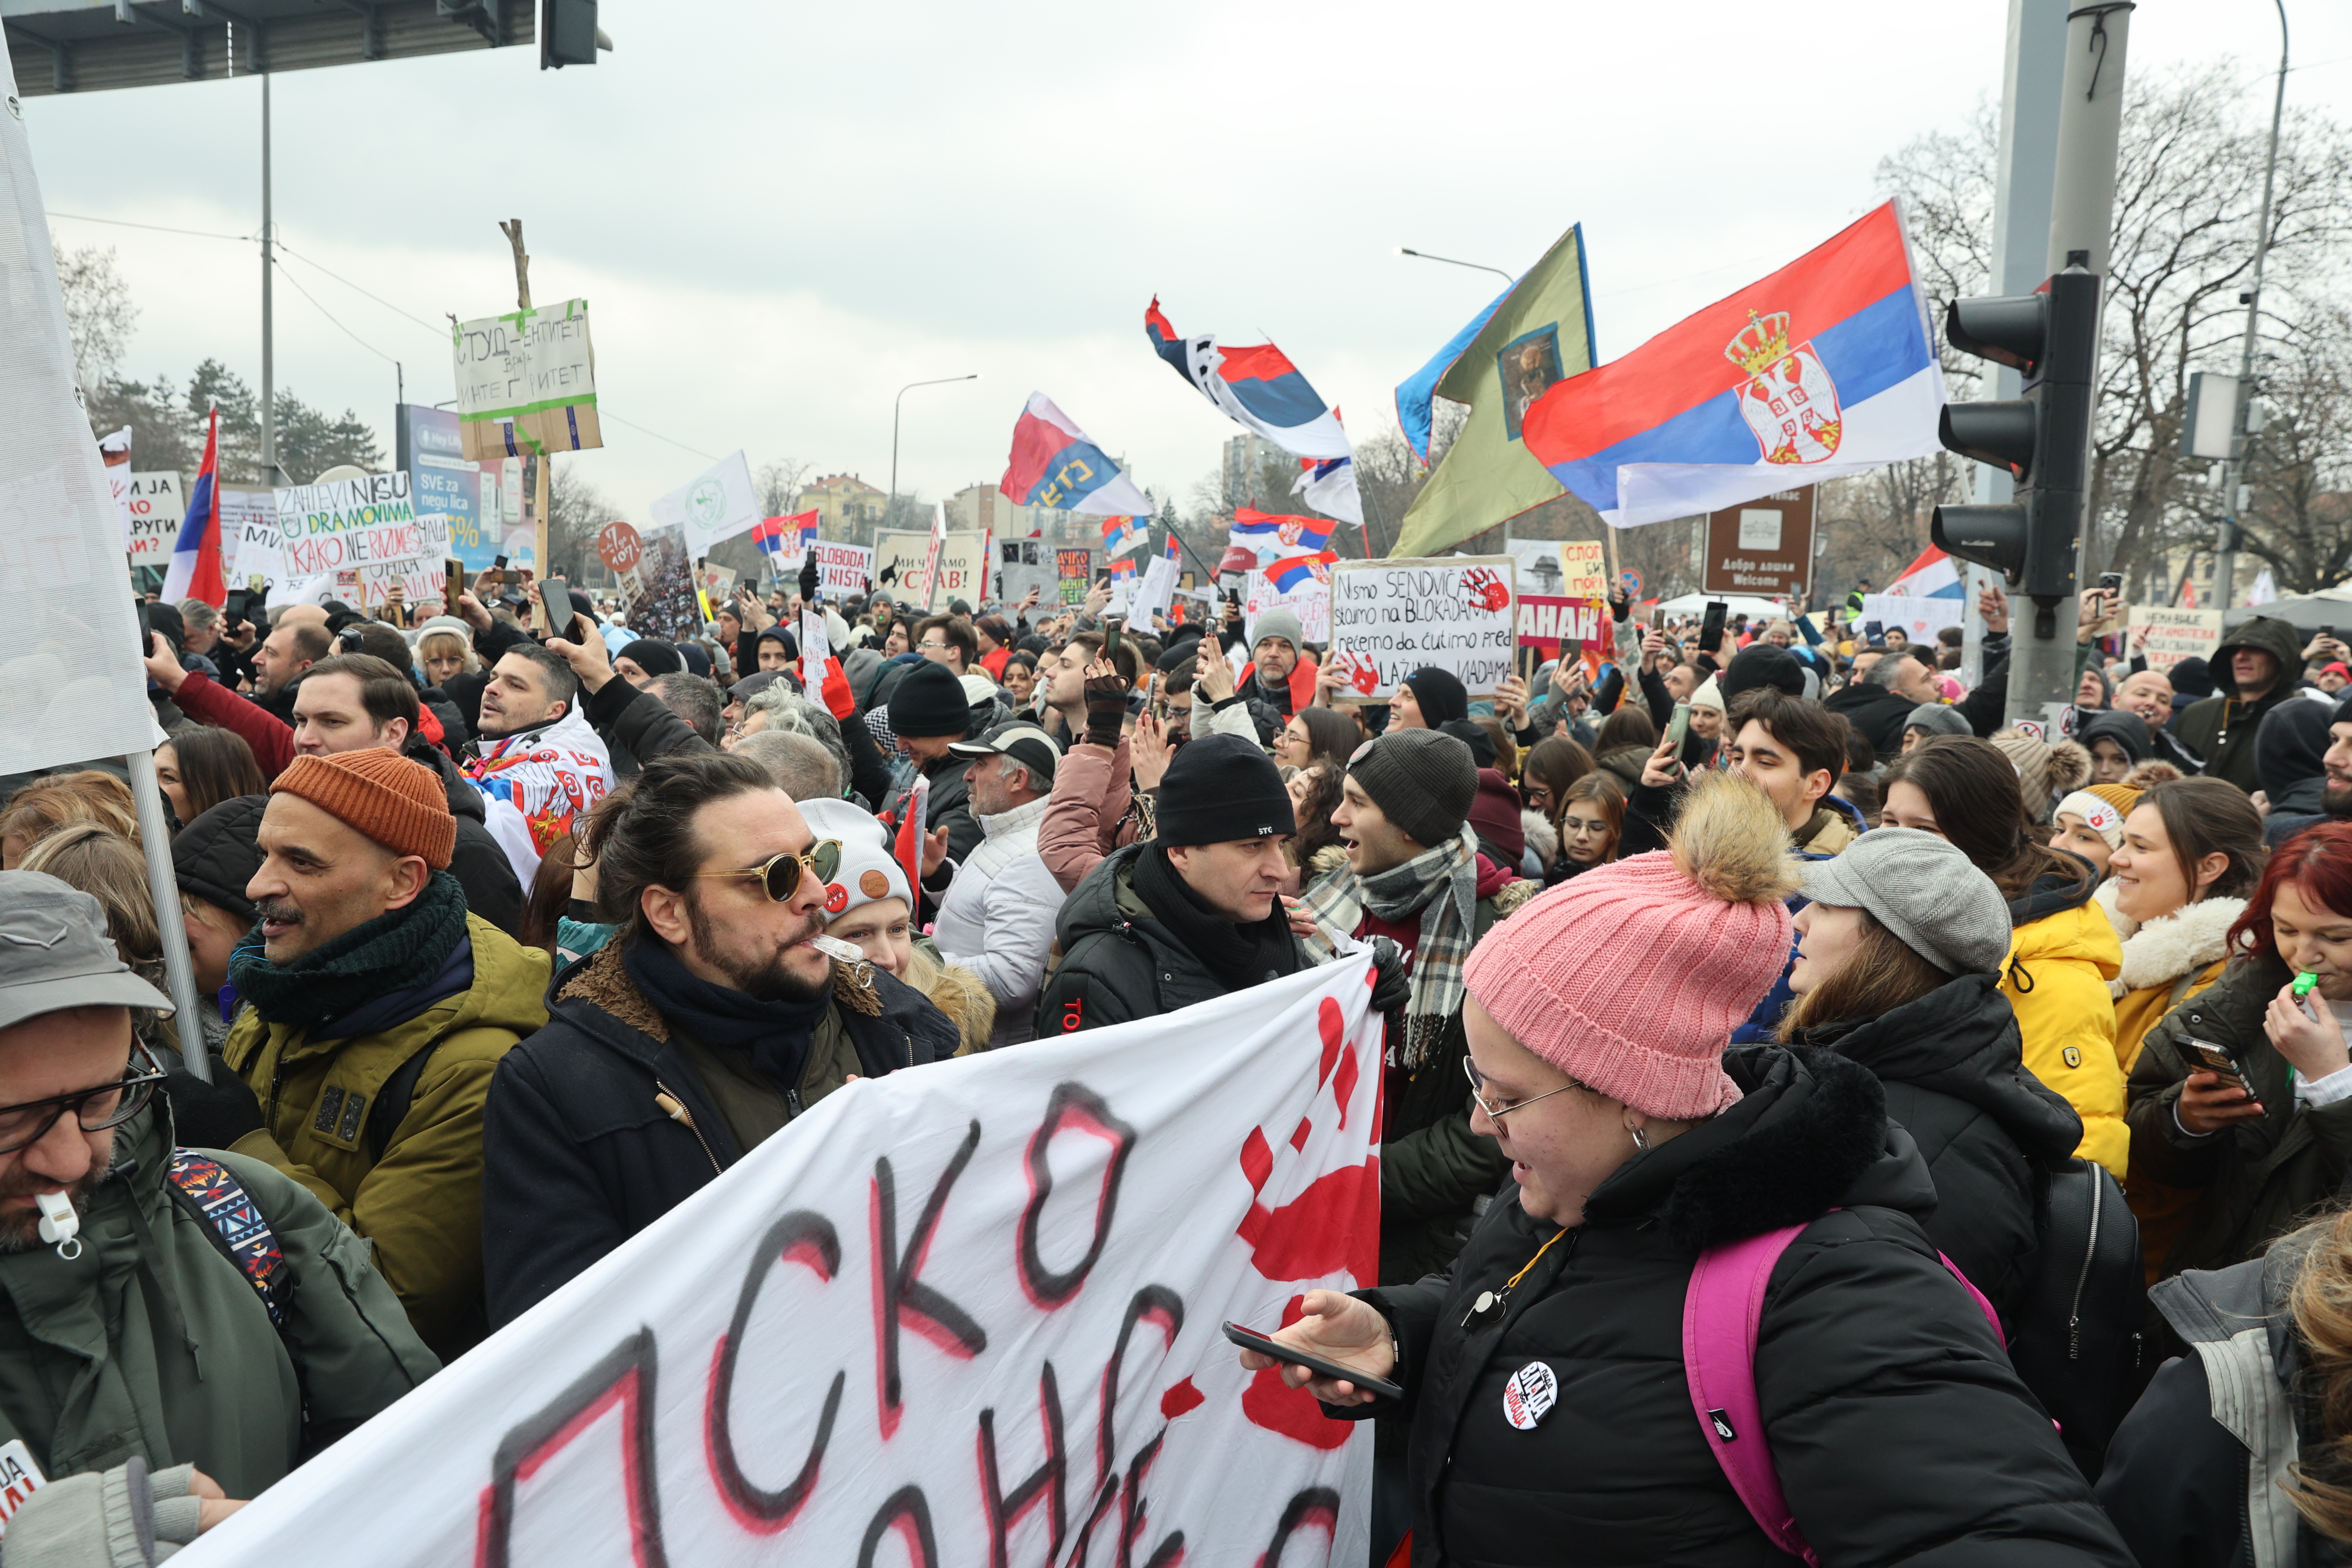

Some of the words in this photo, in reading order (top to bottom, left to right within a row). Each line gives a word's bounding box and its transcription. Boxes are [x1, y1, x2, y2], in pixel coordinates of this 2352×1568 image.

[350, 472, 409, 505] NISU
[420, 473, 444, 490] SVE
[446, 480, 459, 492] za
[307, 500, 414, 534] DRAMOVIMA
[421, 494, 448, 511] negu
[450, 494, 469, 509] lica
[292, 537, 343, 574] KAKO
[345, 532, 368, 562] NE
[1722, 558, 1755, 573] Добро
[1759, 562, 1795, 572] дошли
[1387, 568, 1492, 598] SENDVIČARI
[1733, 573, 1779, 587] Welcome
[1335, 607, 1377, 626] stojimo
[1382, 607, 1401, 622] na
[1406, 597, 1498, 622] BLOKADAMA
[1517, 603, 1599, 641] АНАК
[1339, 635, 1392, 652] nećemo
[1396, 631, 1417, 650] da
[1421, 630, 1477, 650] ćutimo
[1482, 628, 1512, 648] pred
